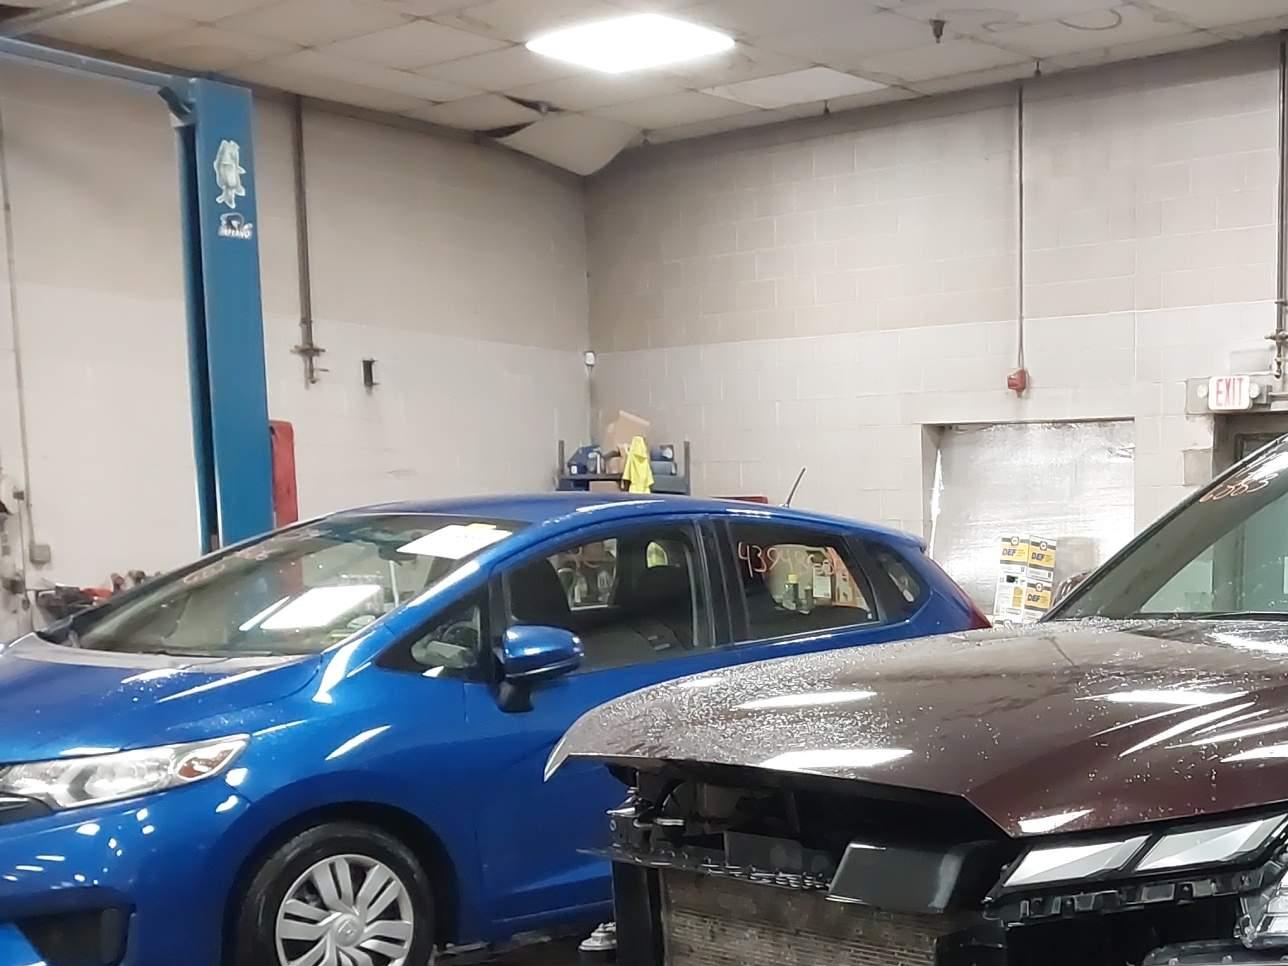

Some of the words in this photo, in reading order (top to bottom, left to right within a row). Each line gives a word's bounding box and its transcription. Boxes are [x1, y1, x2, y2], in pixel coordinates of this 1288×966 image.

[1216, 378, 1244, 406] EXIT
[1031, 552, 1046, 561] DEF
[1027, 593, 1041, 602] DEF
